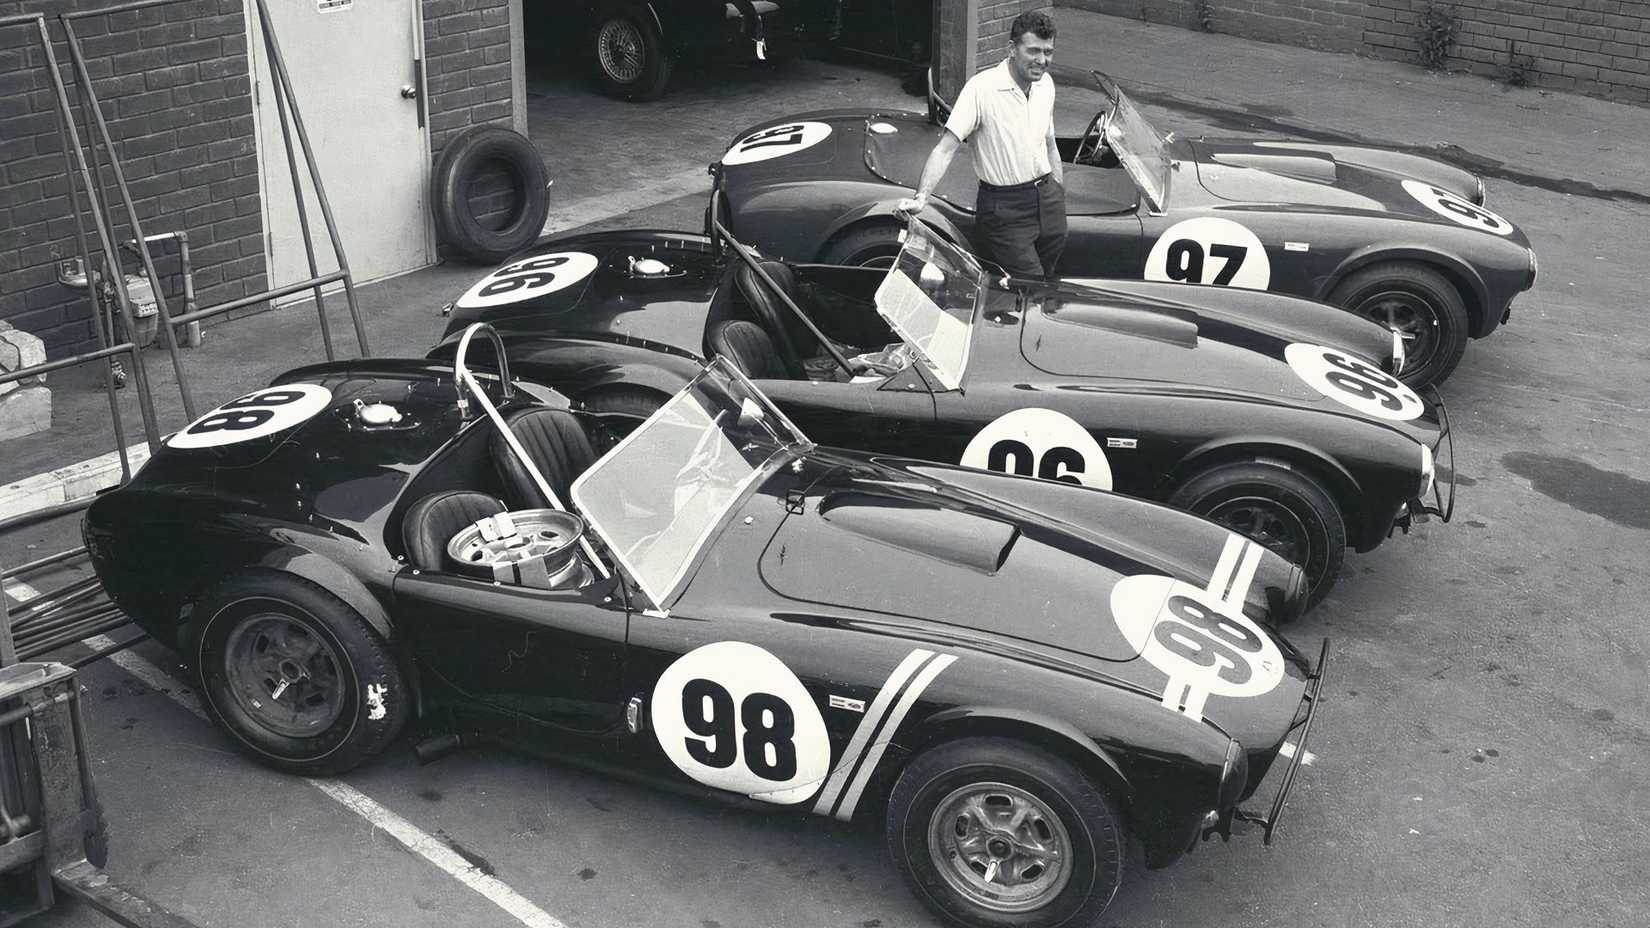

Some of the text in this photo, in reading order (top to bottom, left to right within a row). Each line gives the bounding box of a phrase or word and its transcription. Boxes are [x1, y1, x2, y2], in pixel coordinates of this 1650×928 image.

[740, 125, 804, 153] 97
[479, 256, 570, 297] 96
[1166, 238, 1248, 286] 97
[1322, 352, 1402, 411] 96
[187, 390, 306, 435] 98
[1153, 595, 1263, 685] 98
[681, 678, 797, 782] 98
